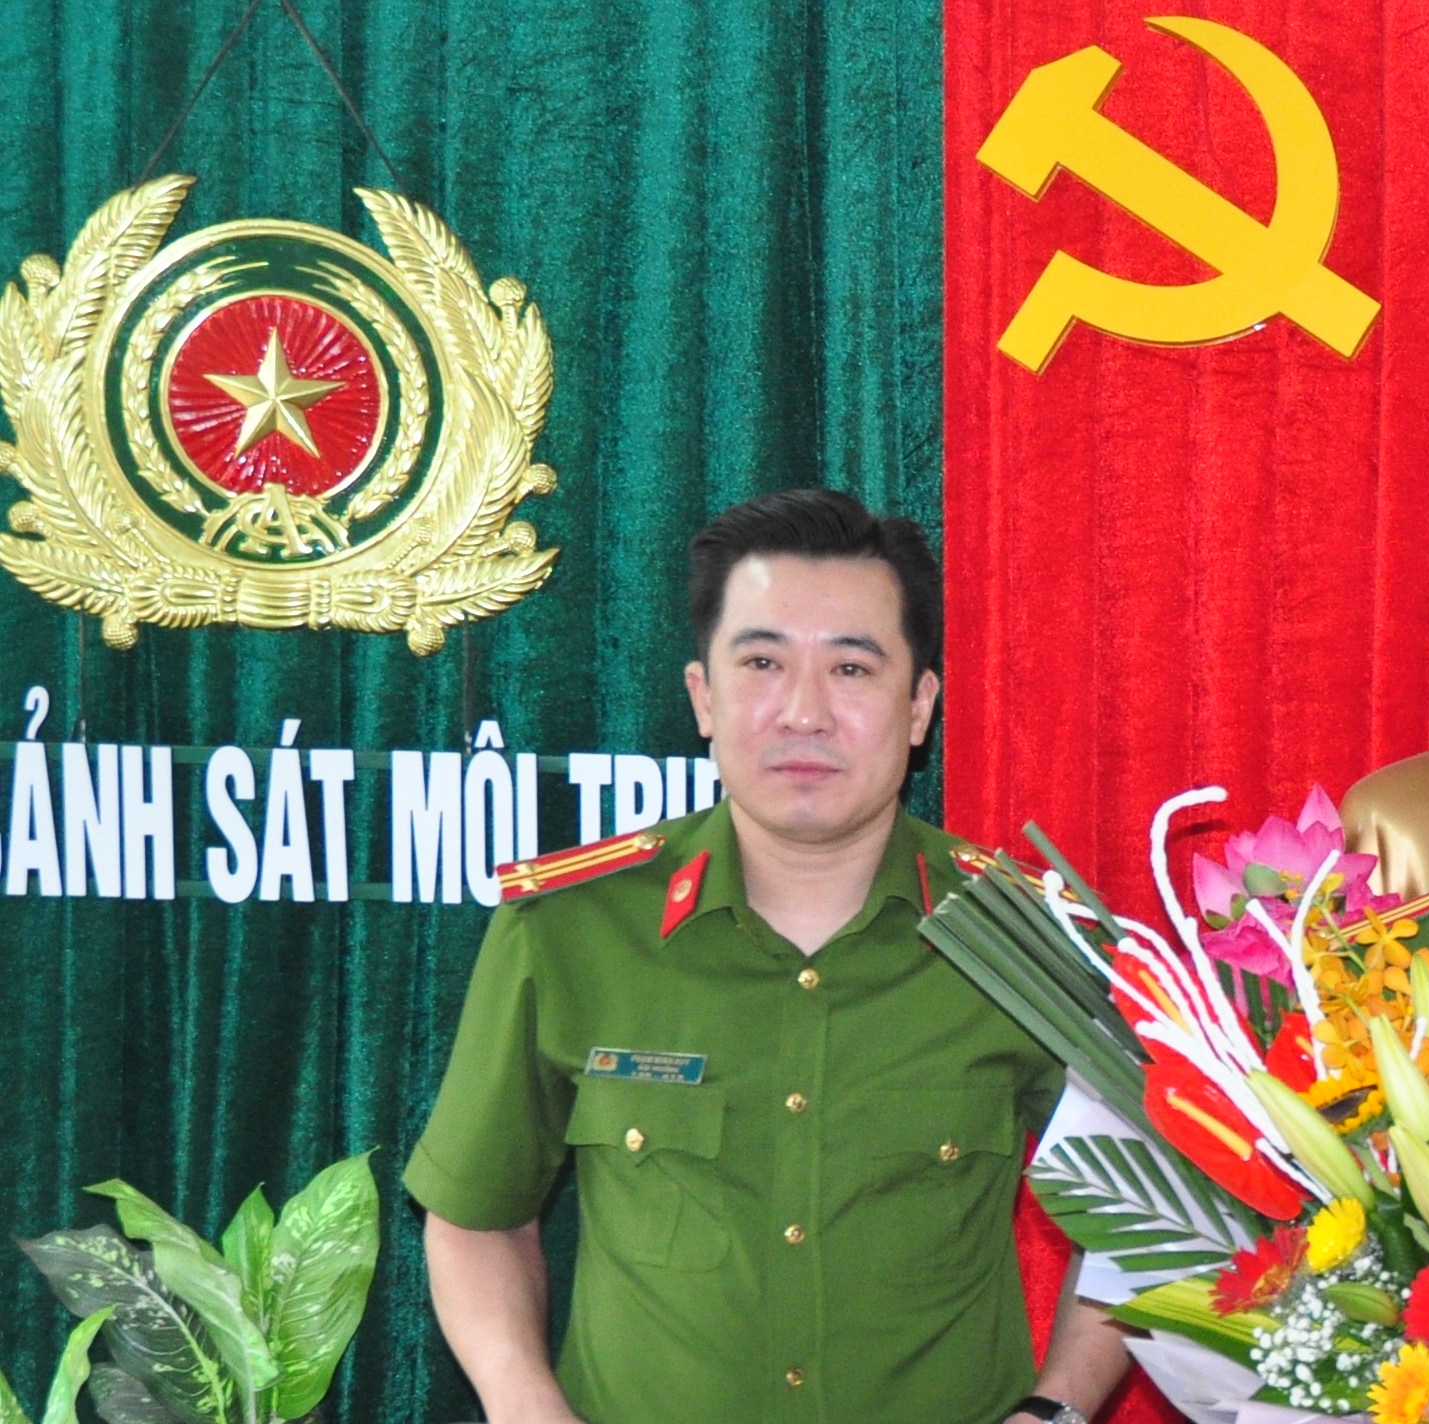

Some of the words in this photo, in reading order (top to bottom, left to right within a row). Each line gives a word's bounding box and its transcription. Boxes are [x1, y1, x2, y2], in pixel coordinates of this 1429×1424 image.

[0, 686, 176, 900] ẢNH
[206, 720, 354, 903] SÁT
[391, 722, 538, 906] MÔI
